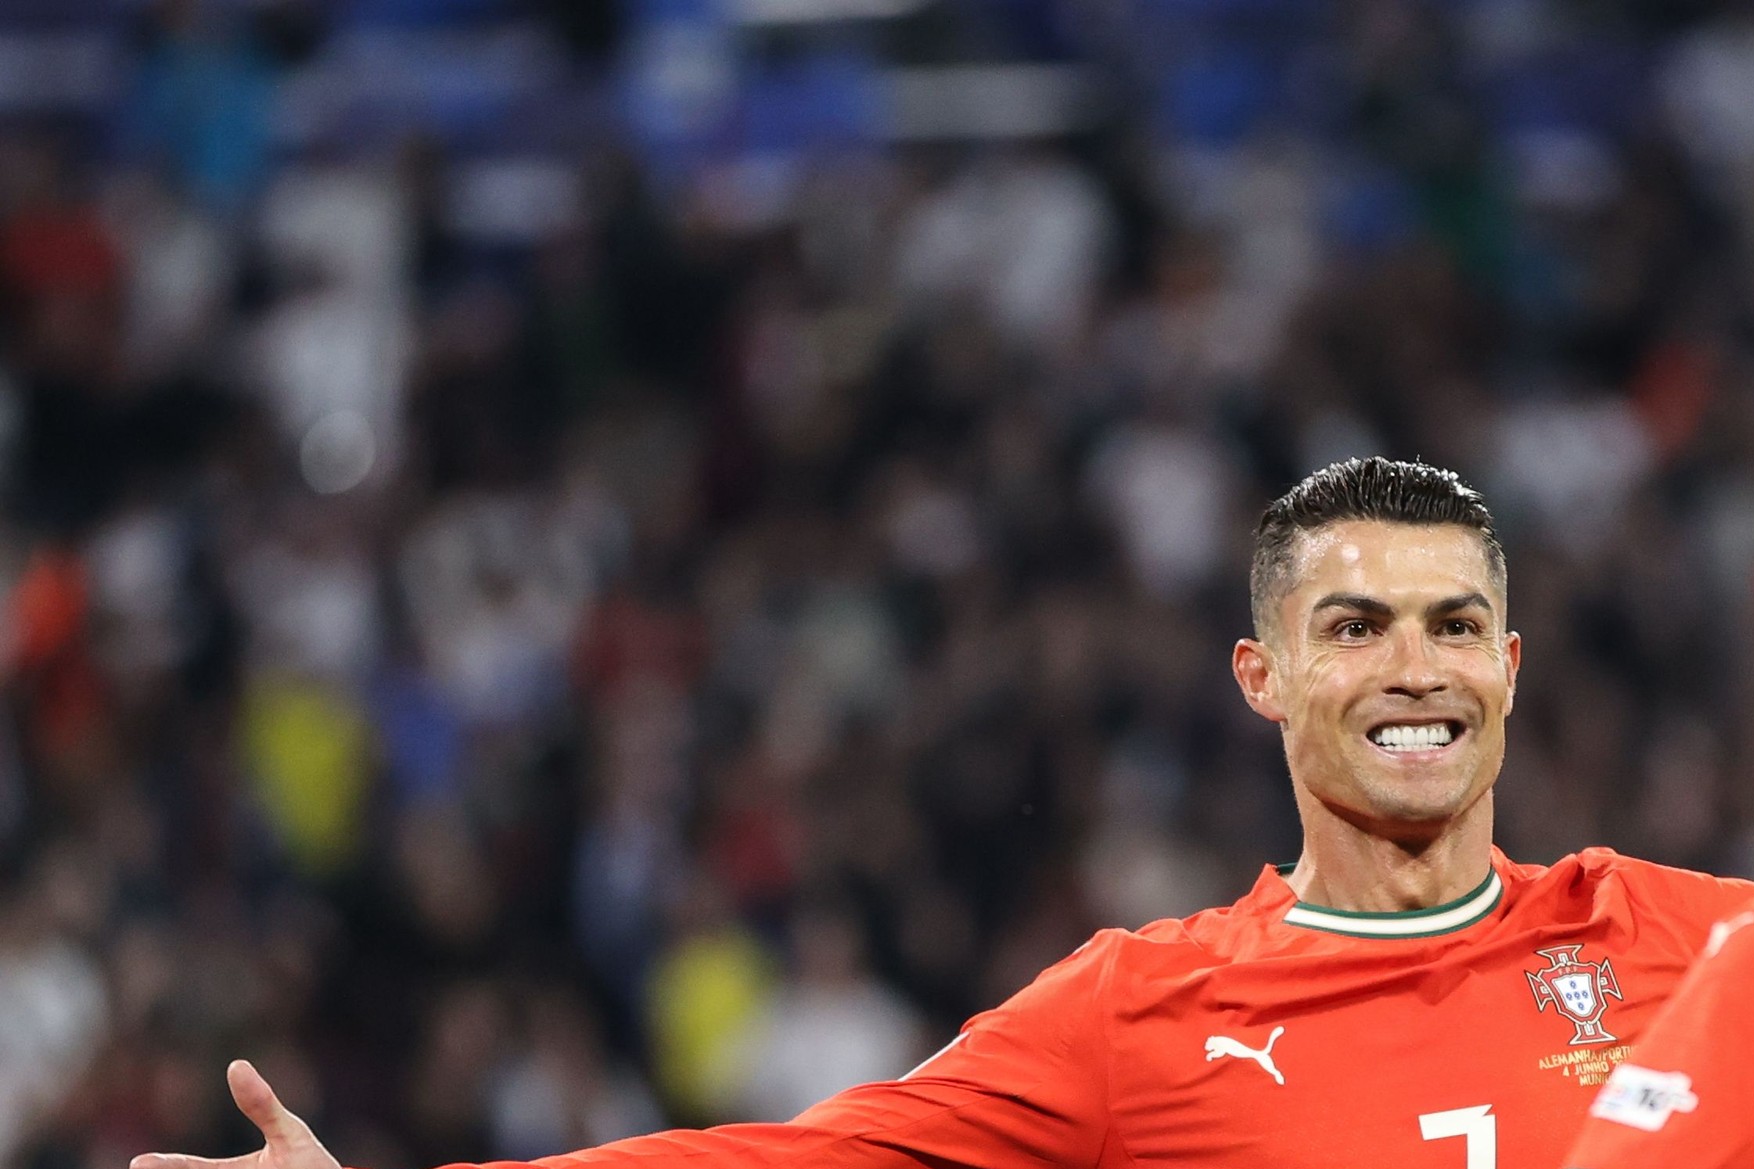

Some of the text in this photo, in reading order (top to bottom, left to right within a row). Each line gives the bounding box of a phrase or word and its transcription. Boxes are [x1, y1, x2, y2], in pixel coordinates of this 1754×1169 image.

[1538, 1045, 1633, 1070] ALEMANHA/PORTU
[1562, 1065, 1570, 1077] 4
[1574, 1061, 1610, 1076] JUNHO
